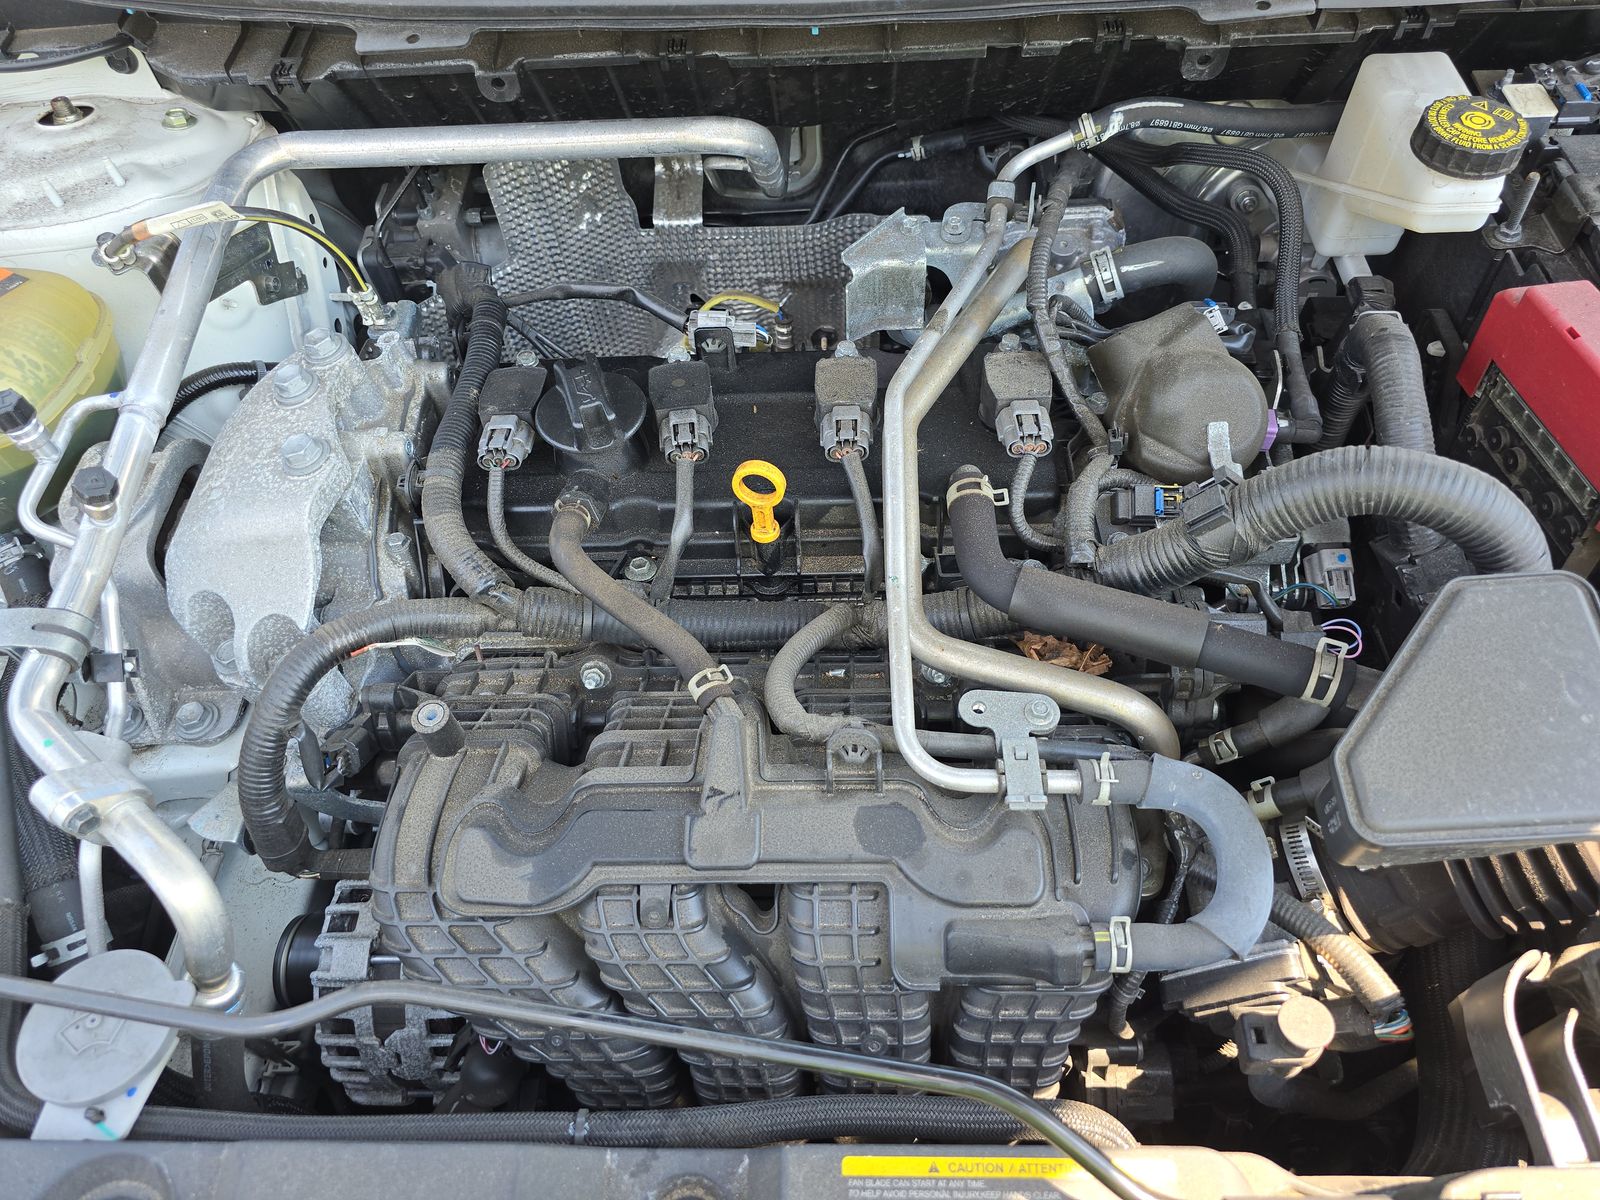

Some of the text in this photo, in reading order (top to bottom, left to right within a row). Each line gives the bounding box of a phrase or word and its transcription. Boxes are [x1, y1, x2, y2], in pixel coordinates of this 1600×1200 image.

[1150, 119, 1183, 129] GB16897
[1446, 127, 1460, 136] CAP
[1459, 133, 1487, 143] BEFORE
[1451, 137, 1472, 147] FLUID
[948, 1162, 1003, 1174] CAUTION
[848, 1178, 864, 1187] FAN
[865, 1178, 892, 1187] BLADE
[893, 1179, 910, 1187] CAN
[911, 1179, 935, 1187] START
[938, 1179, 946, 1187] AT
[948, 1180, 964, 1188] ANY
[848, 1189, 860, 1198] TO
[861, 1189, 881, 1198] HELP
[882, 1189, 908, 1198] AVOID
[909, 1190, 951, 1199] PERSONAL
